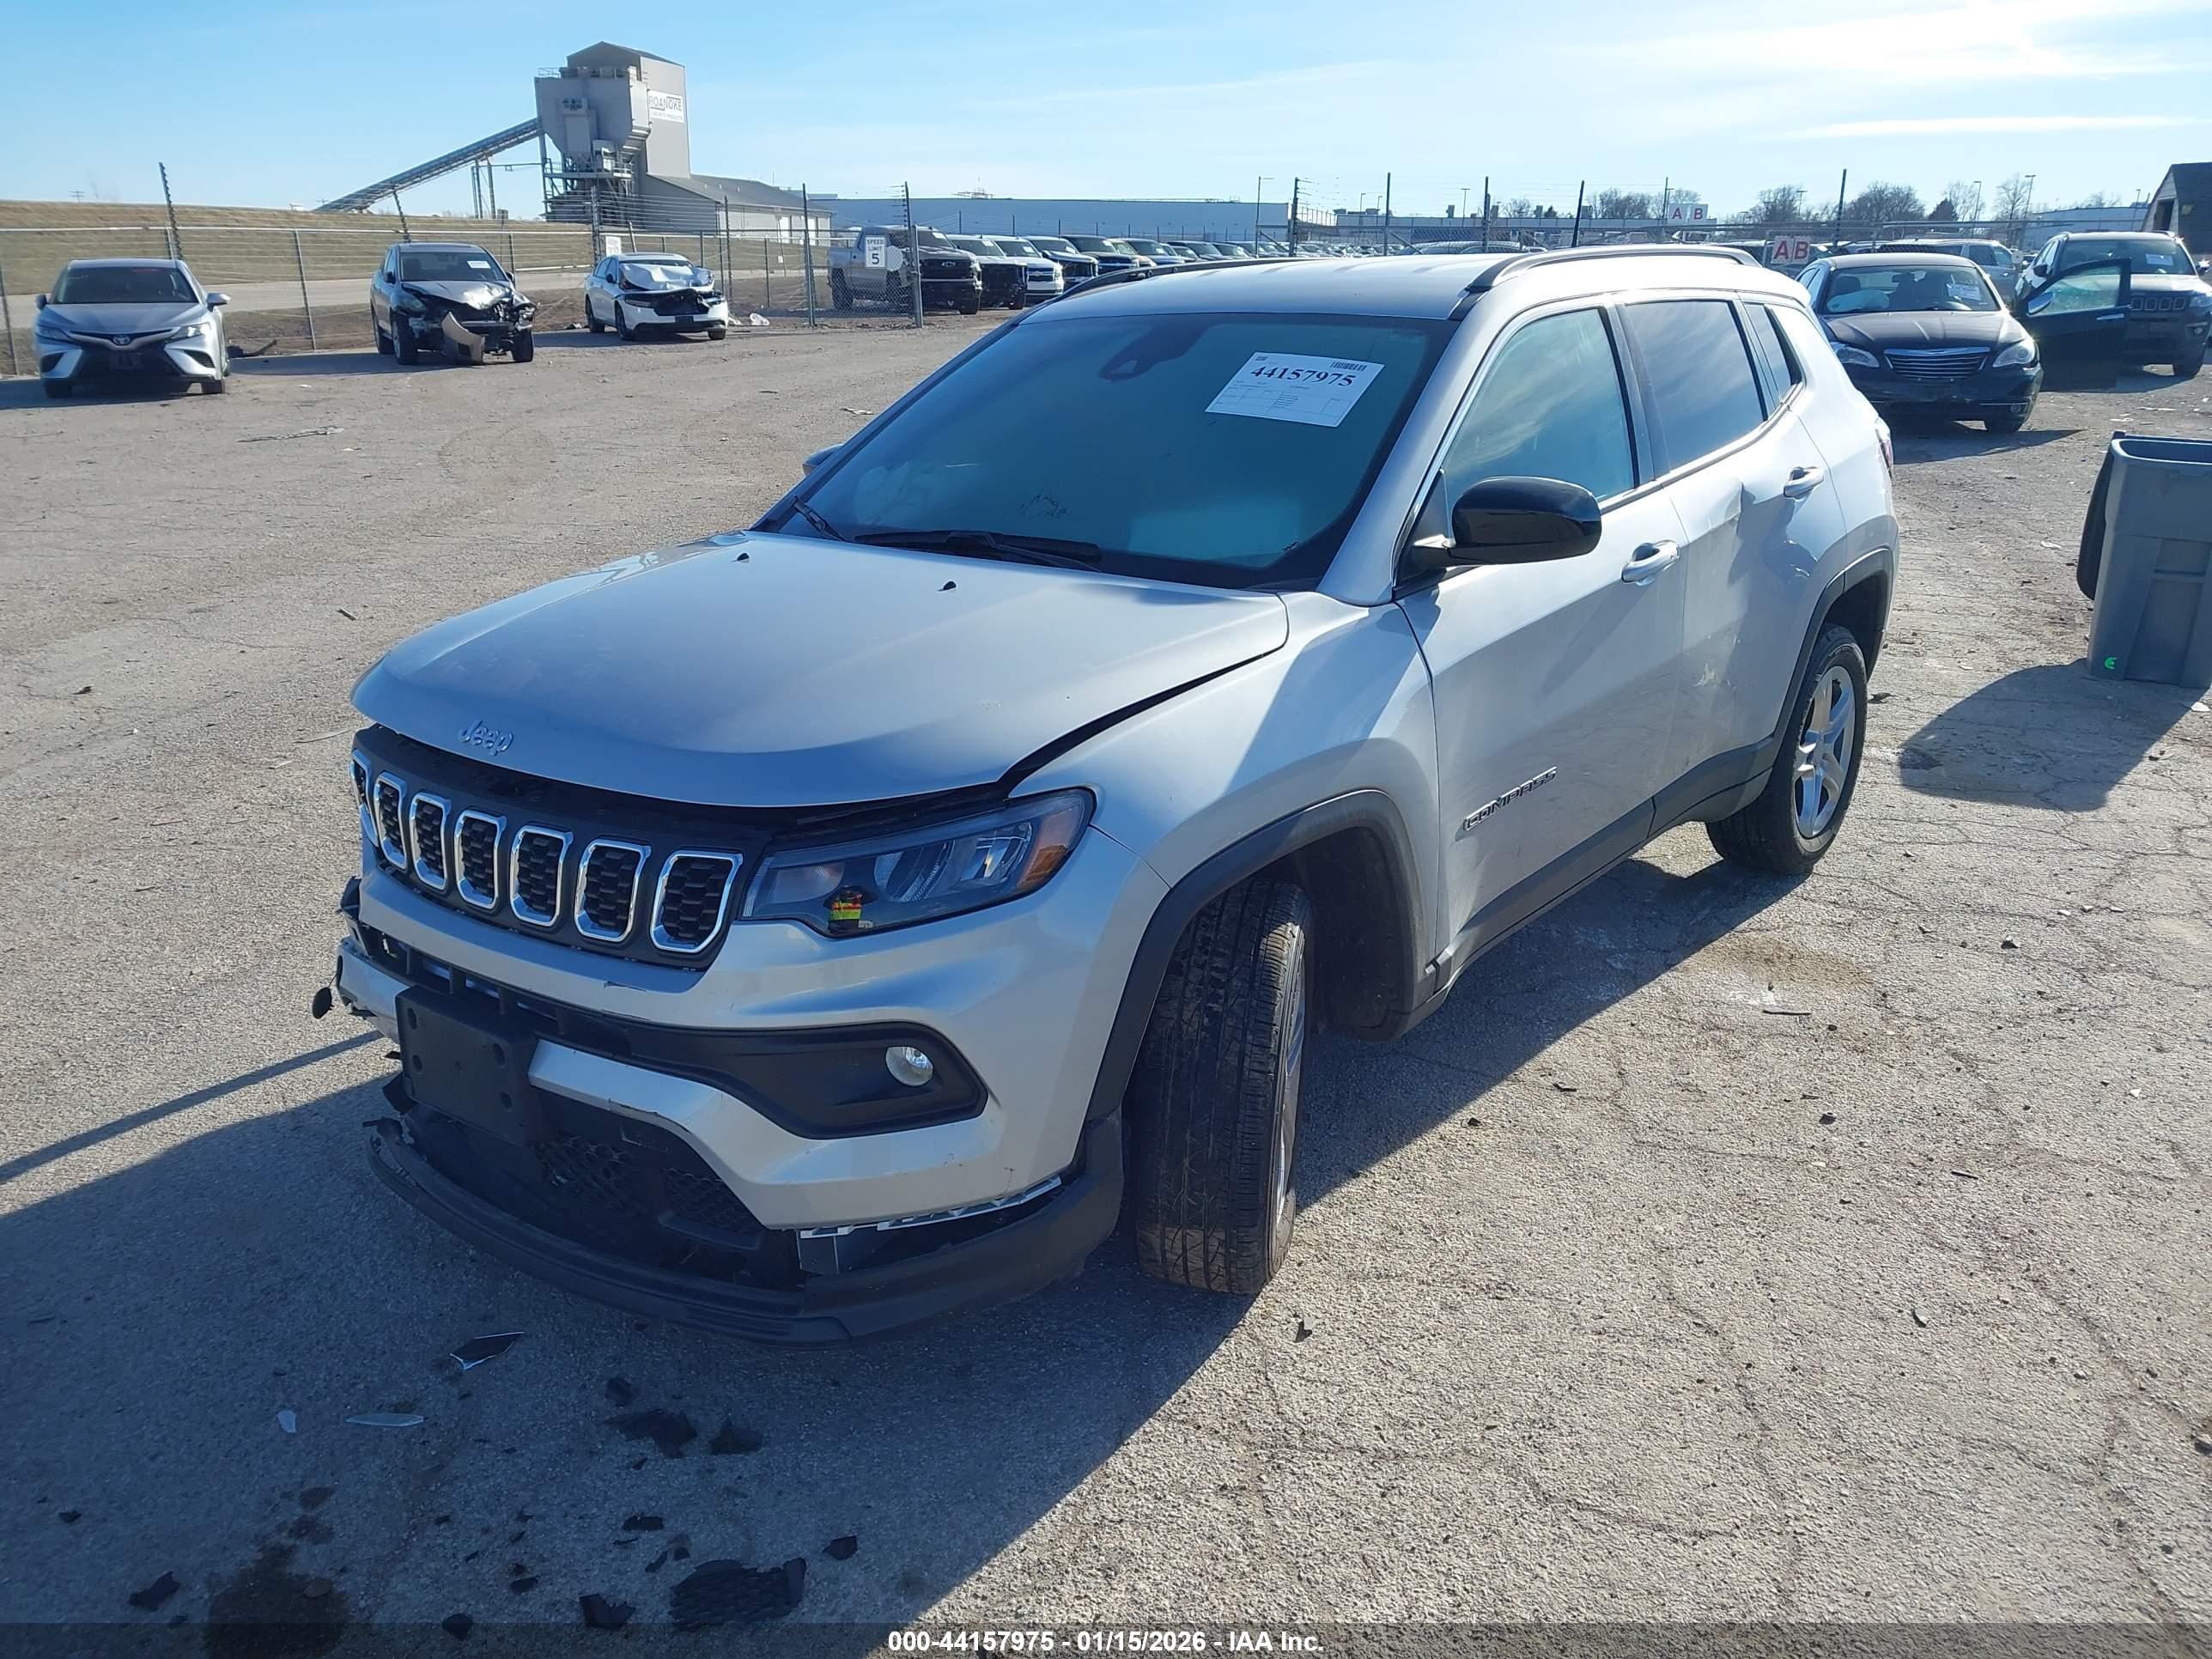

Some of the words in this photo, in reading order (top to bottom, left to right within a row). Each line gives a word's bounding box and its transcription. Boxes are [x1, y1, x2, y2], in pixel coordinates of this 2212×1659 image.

[649, 96, 682, 111] ROANOKE
[1672, 208, 1682, 220] A
[1694, 208, 1704, 220] B
[872, 253, 879, 264] 5
[1773, 240, 1790, 259] A
[1795, 241, 1809, 260] B
[1250, 366, 1356, 386] 44157975
[459, 720, 514, 757] Jeep
[1462, 766, 1558, 831] COMPASS
